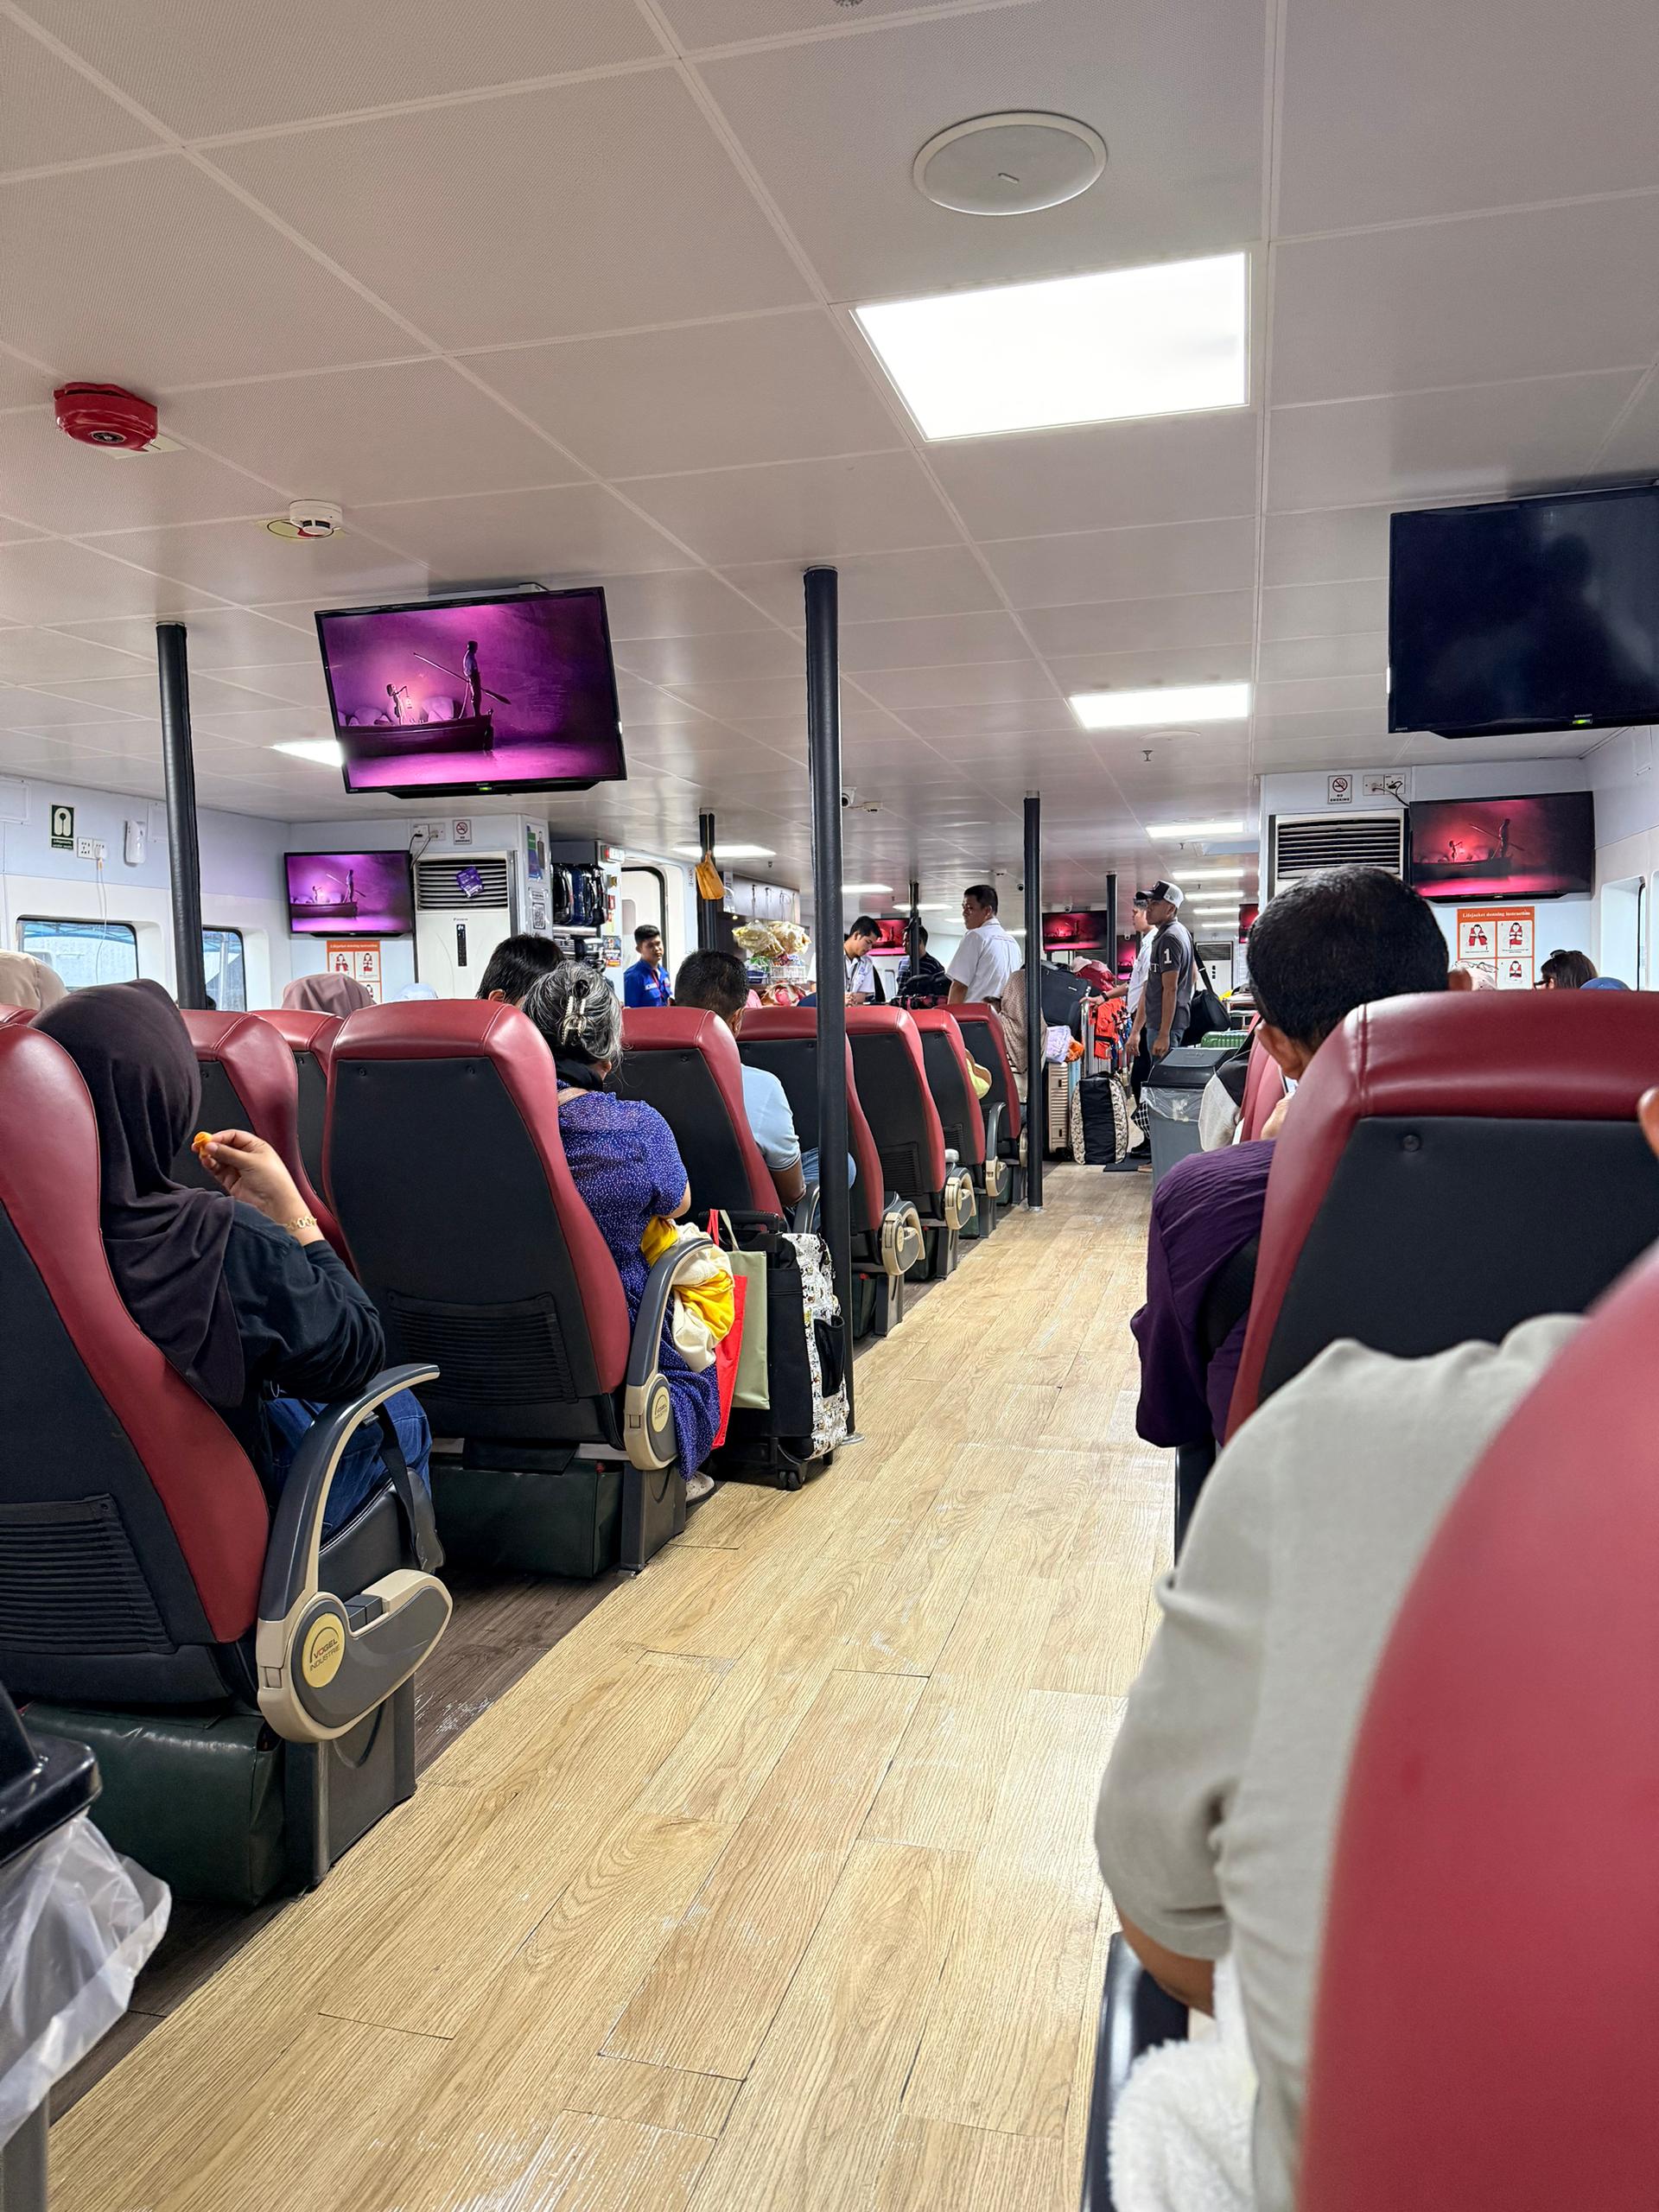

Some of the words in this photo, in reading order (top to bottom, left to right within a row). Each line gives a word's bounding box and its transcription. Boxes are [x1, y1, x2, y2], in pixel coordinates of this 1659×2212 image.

[1163, 948, 1173, 964] 1
[310, 1643, 340, 1671] INDUSTRIE
[314, 1638, 338, 1659] VOGEL
